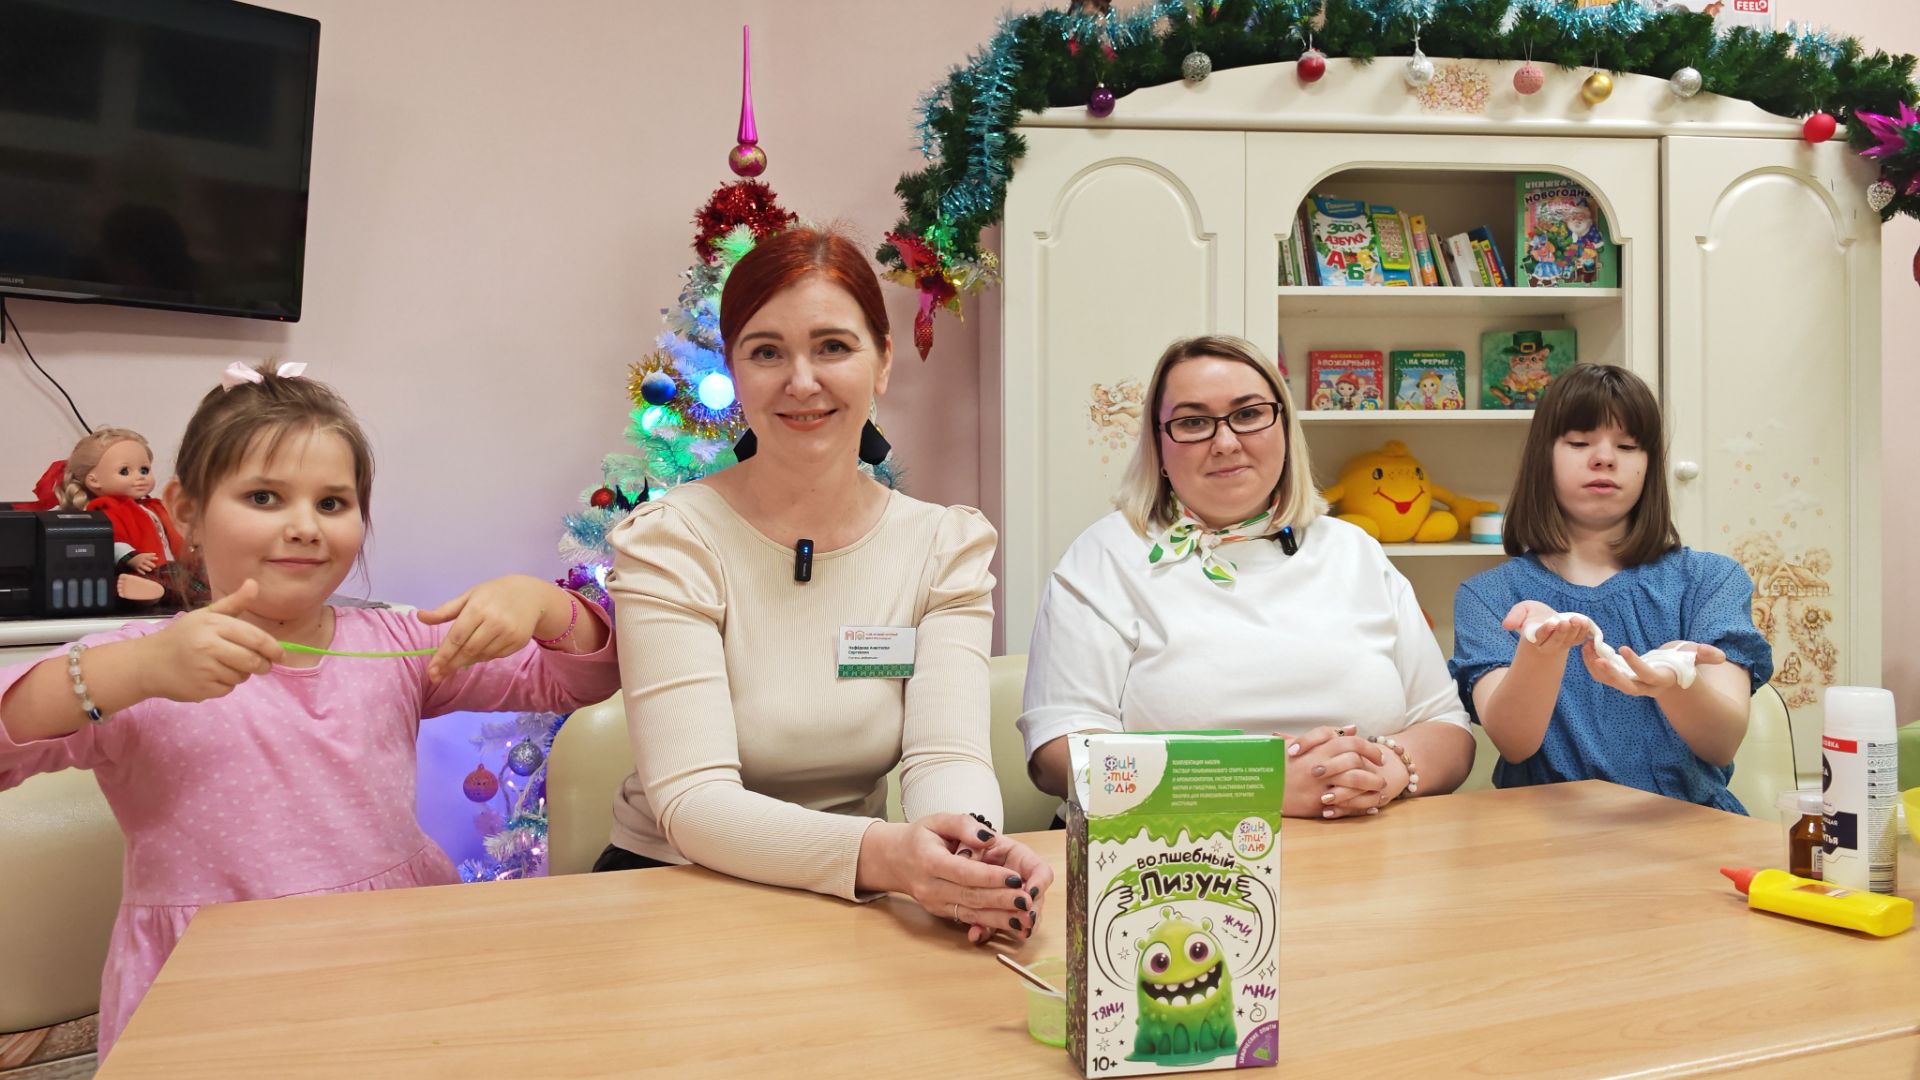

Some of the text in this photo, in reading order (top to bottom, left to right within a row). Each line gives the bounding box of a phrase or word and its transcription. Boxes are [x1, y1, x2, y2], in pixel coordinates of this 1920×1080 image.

[1325, 232, 1367, 246] АЗБУКА
[1326, 250, 1346, 269] А
[1140, 870, 1233, 901] Лизун
[1222, 914, 1253, 937] ЖМИ
[1242, 984, 1277, 1000] МНИ
[1091, 1002, 1125, 1021] ТЯНИ
[1092, 1056, 1118, 1072] 10+
